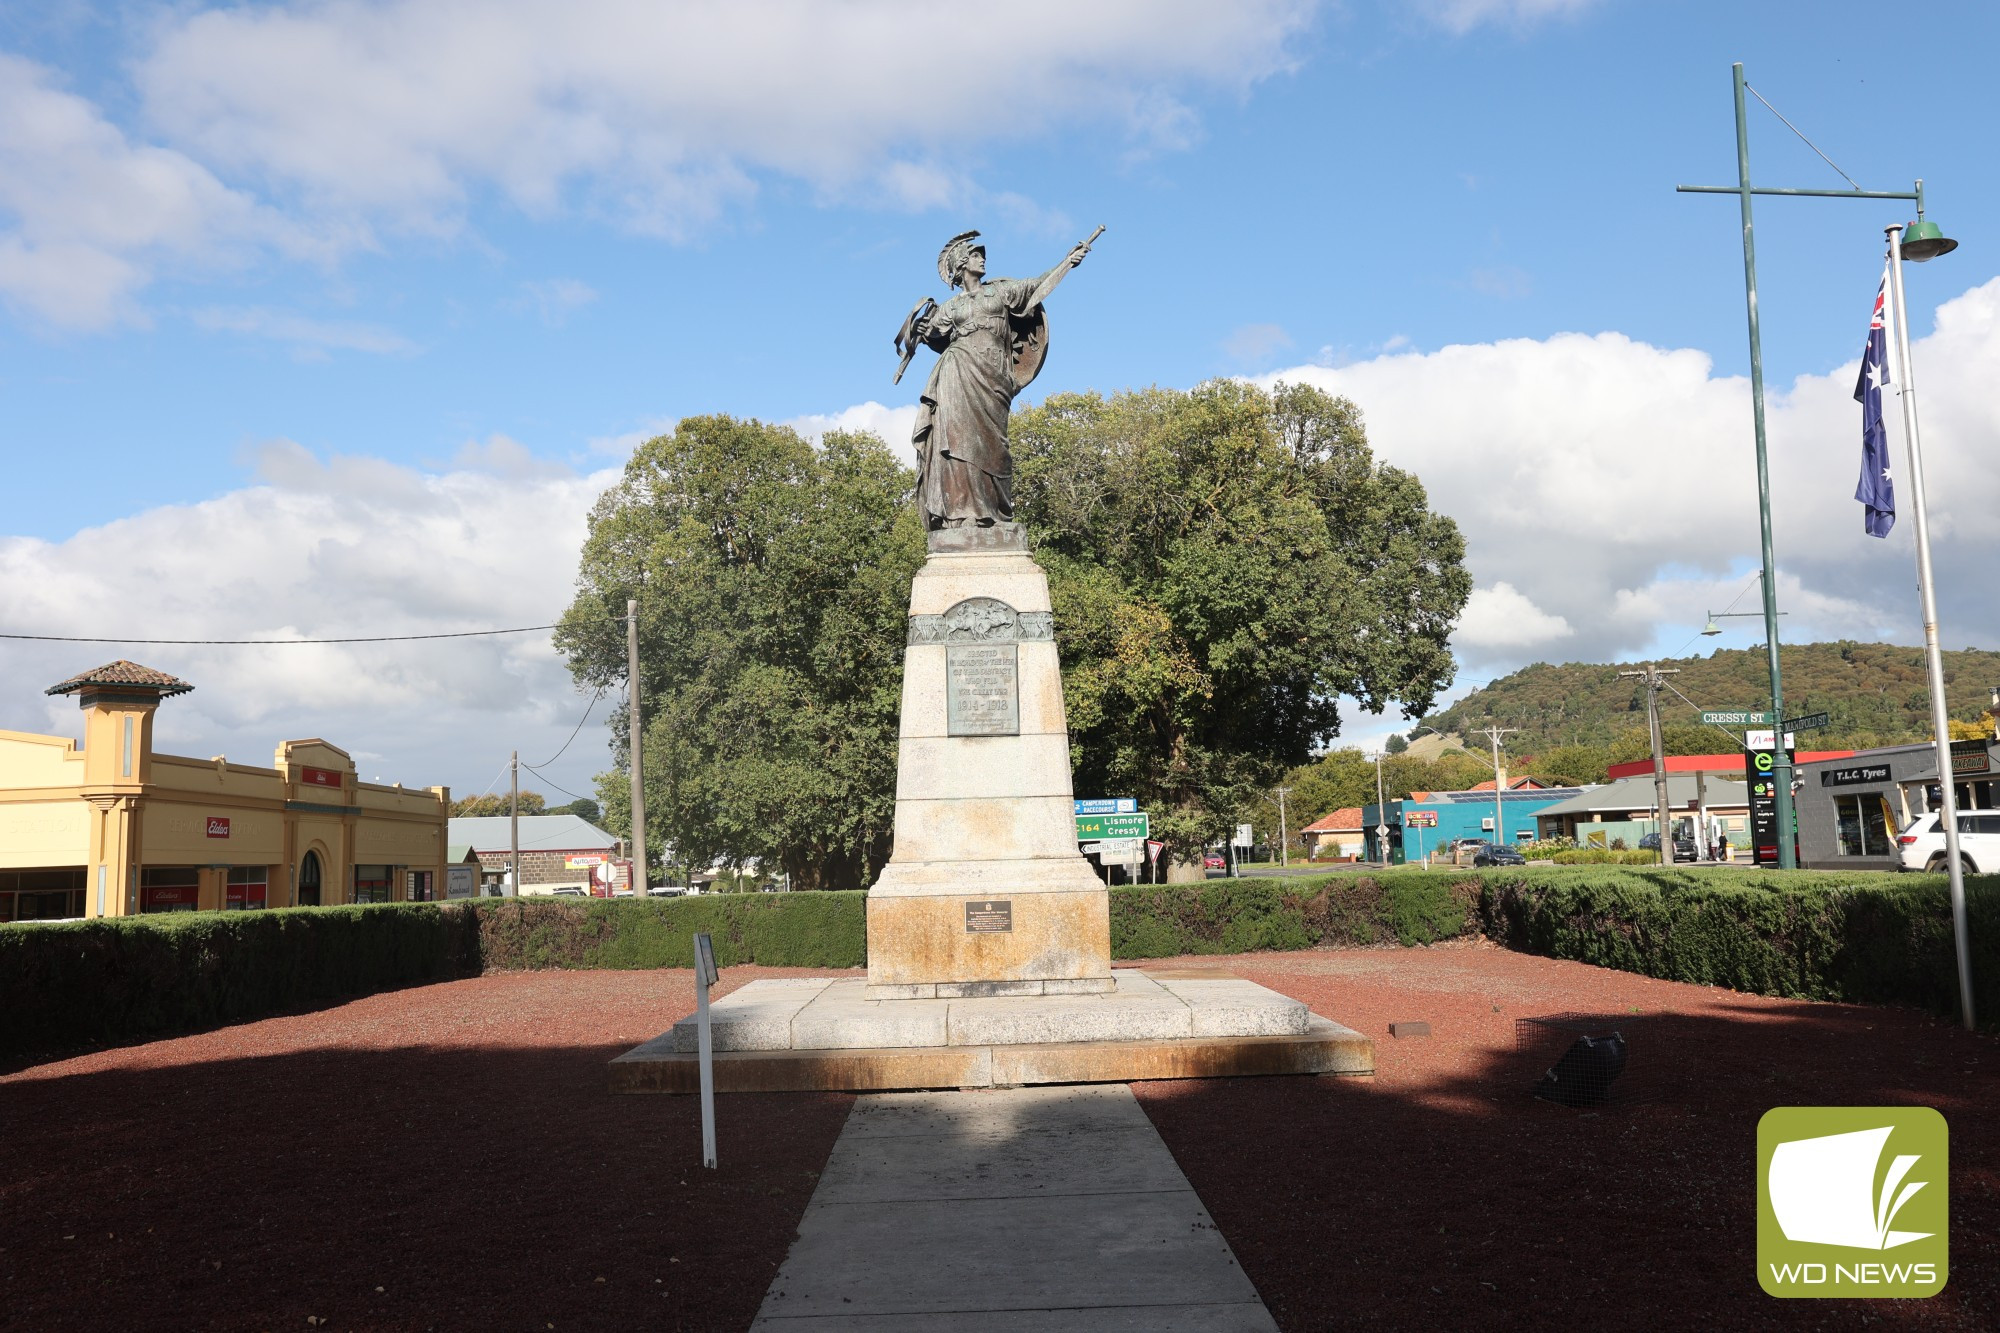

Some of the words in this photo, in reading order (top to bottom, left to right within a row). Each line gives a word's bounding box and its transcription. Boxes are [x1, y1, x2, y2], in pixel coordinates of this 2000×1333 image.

[1703, 713, 1747, 723] CRESSY
[1750, 713, 1764, 723] ST
[1784, 717, 1817, 732] MANIFOLD
[1817, 715, 1827, 726] ST
[1837, 771, 1859, 780] T.L.C.
[1862, 769, 1886, 779] Tyres
[1104, 817, 1144, 825] Lismore
[208, 820, 228, 834] Elders
[1108, 827, 1139, 836] Cressy
[1114, 841, 1130, 850] ESTATE
